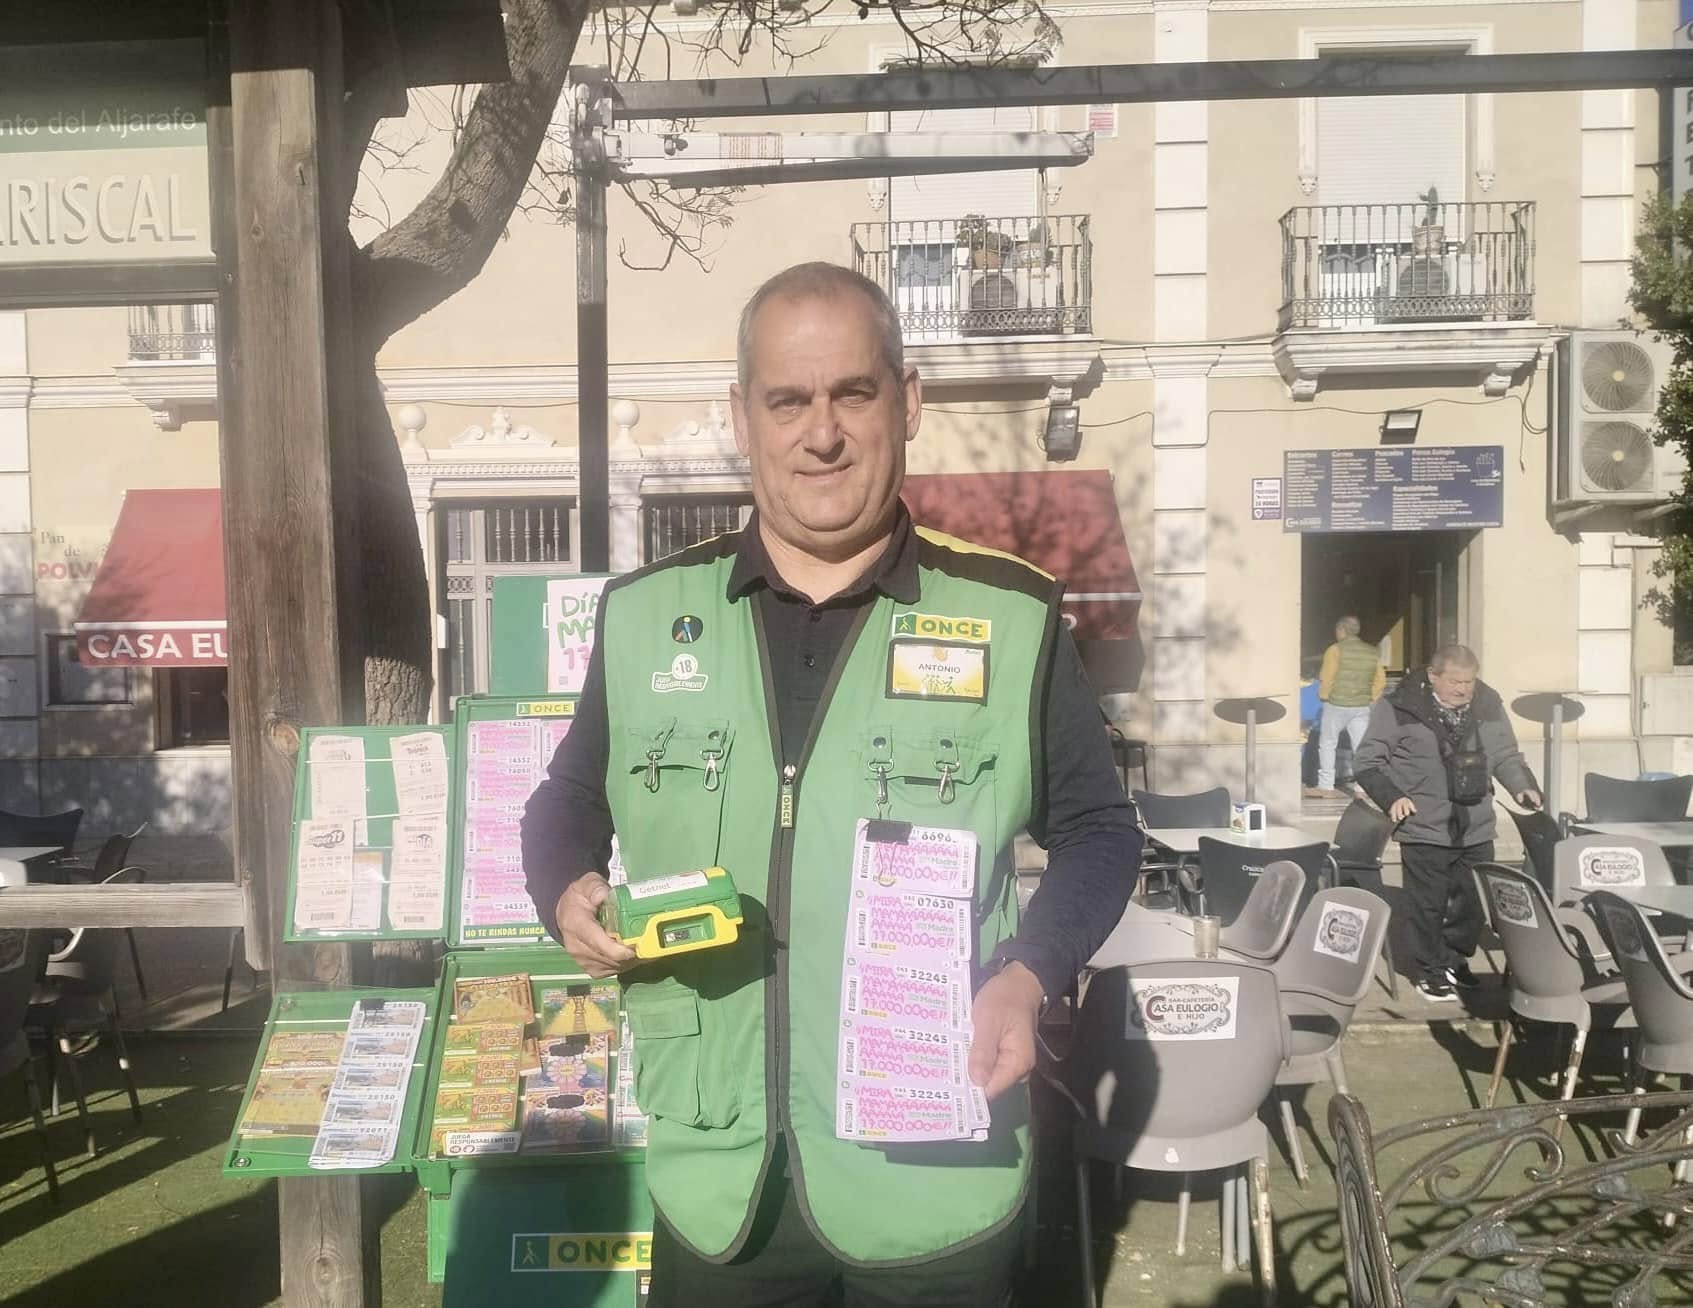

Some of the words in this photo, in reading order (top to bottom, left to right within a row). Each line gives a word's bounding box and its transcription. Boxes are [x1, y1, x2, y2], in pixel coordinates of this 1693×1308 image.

[47, 109, 87, 134] del
[95, 107, 197, 138] Aljarafe
[0, 173, 198, 246] RISCAL
[40, 531, 65, 544] Pan
[63, 544, 81, 557] de
[36, 561, 98, 580] POLV
[920, 619, 982, 638] ONCE
[87, 634, 183, 660] CASA
[918, 663, 961, 674] ANTONIO
[534, 704, 570, 713] ONCE
[917, 897, 955, 909] 07630
[465, 929, 476, 938] NO
[478, 928, 487, 937] TE
[909, 968, 949, 985] 32245
[1146, 995, 1174, 1021] CASA
[1176, 1003, 1219, 1013] EULOGIO
[908, 1030, 949, 1044] 32245
[909, 1088, 951, 1100] 32245
[558, 1240, 651, 1263] ONCE
